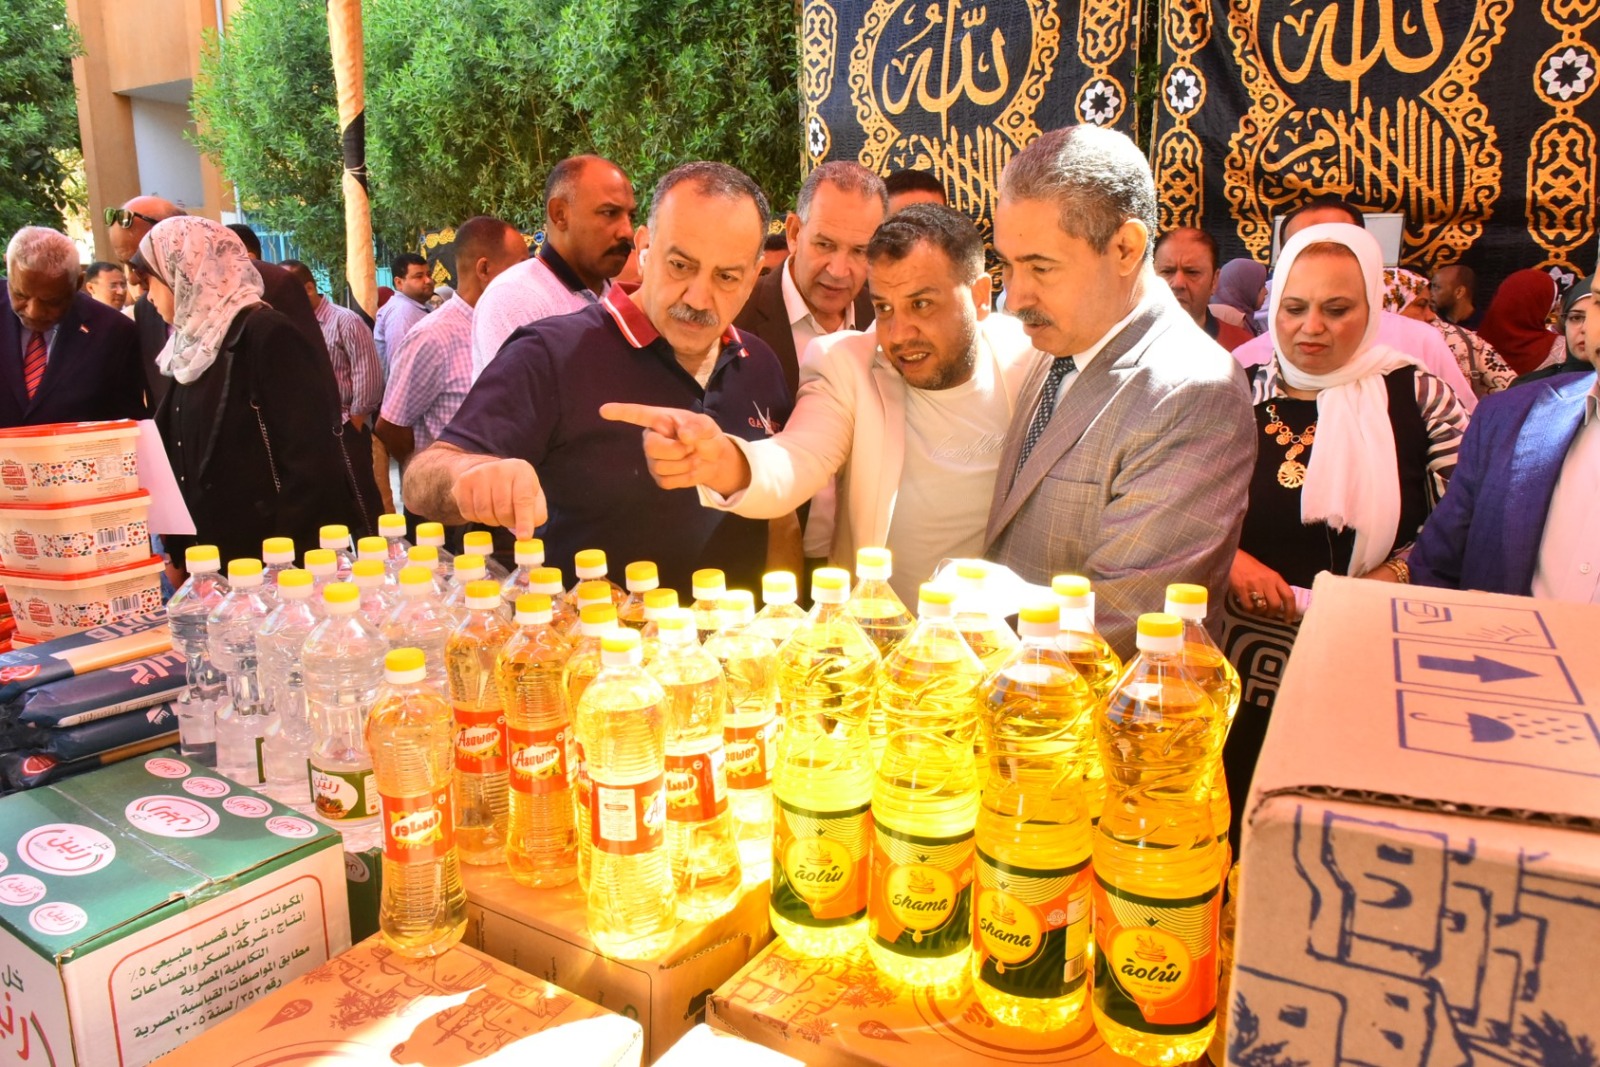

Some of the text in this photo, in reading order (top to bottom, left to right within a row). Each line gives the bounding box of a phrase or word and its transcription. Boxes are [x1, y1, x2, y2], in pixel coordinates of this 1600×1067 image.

[459, 730, 498, 747] Asawer
[515, 748, 557, 767] Asawer
[725, 746, 757, 763] sawer
[147, 805, 192, 826] رنين
[47, 836, 93, 861] رنين
[260, 893, 304, 921] المكونات
[892, 894, 948, 911] Shama
[195, 927, 228, 951] قصب
[231, 918, 250, 937] خل
[236, 927, 269, 951] شركة
[980, 918, 1032, 947] Shama
[150, 947, 192, 975] طبيعي
[200, 945, 236, 971] السكر
[2, 964, 24, 993] خل
[130, 963, 199, 1001] والصناعات
[180, 947, 269, 996] التكاملية المصرية
[134, 945, 310, 1039] مطابق المواصفات القياسية المصرية
[263, 978, 282, 995] رقم
[175, 1015, 206, 1036] ٢٠٠٥
